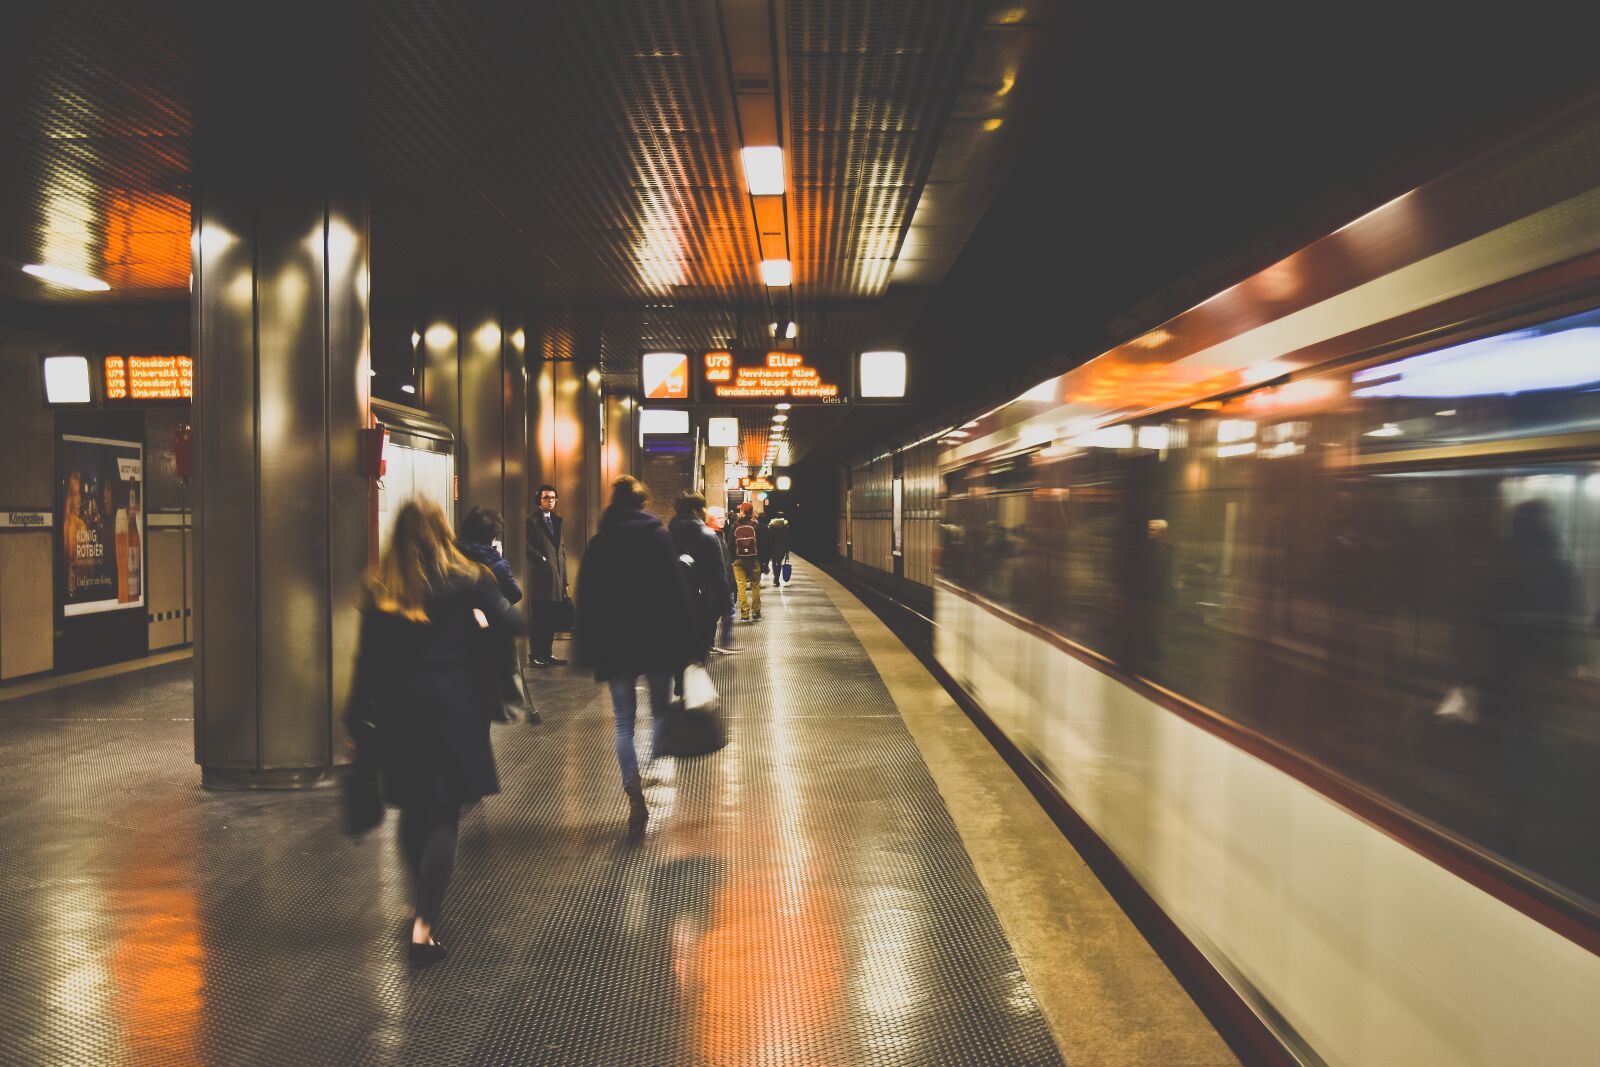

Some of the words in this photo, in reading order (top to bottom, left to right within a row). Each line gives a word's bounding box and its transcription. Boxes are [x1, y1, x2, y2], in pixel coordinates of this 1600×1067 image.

[107, 359, 124, 368] U78
[131, 359, 176, 369] Düsseldorf
[768, 355, 802, 367] Eller
[108, 369, 125, 378] U79
[132, 369, 180, 378] Universität
[739, 369, 789, 378] Vennhauser
[791, 369, 816, 378] Allee
[132, 379, 178, 389] Düsseldorf
[760, 378, 819, 388] Hauptbahnhof
[110, 389, 127, 398] U79
[133, 388, 181, 398] Universität
[717, 387, 785, 397] Handelszentrum
[791, 387, 837, 398] Lierenfeld
[822, 396, 841, 404] Gleis
[8, 511, 45, 526] Königsallee
[76, 543, 104, 559] ROTBIER
